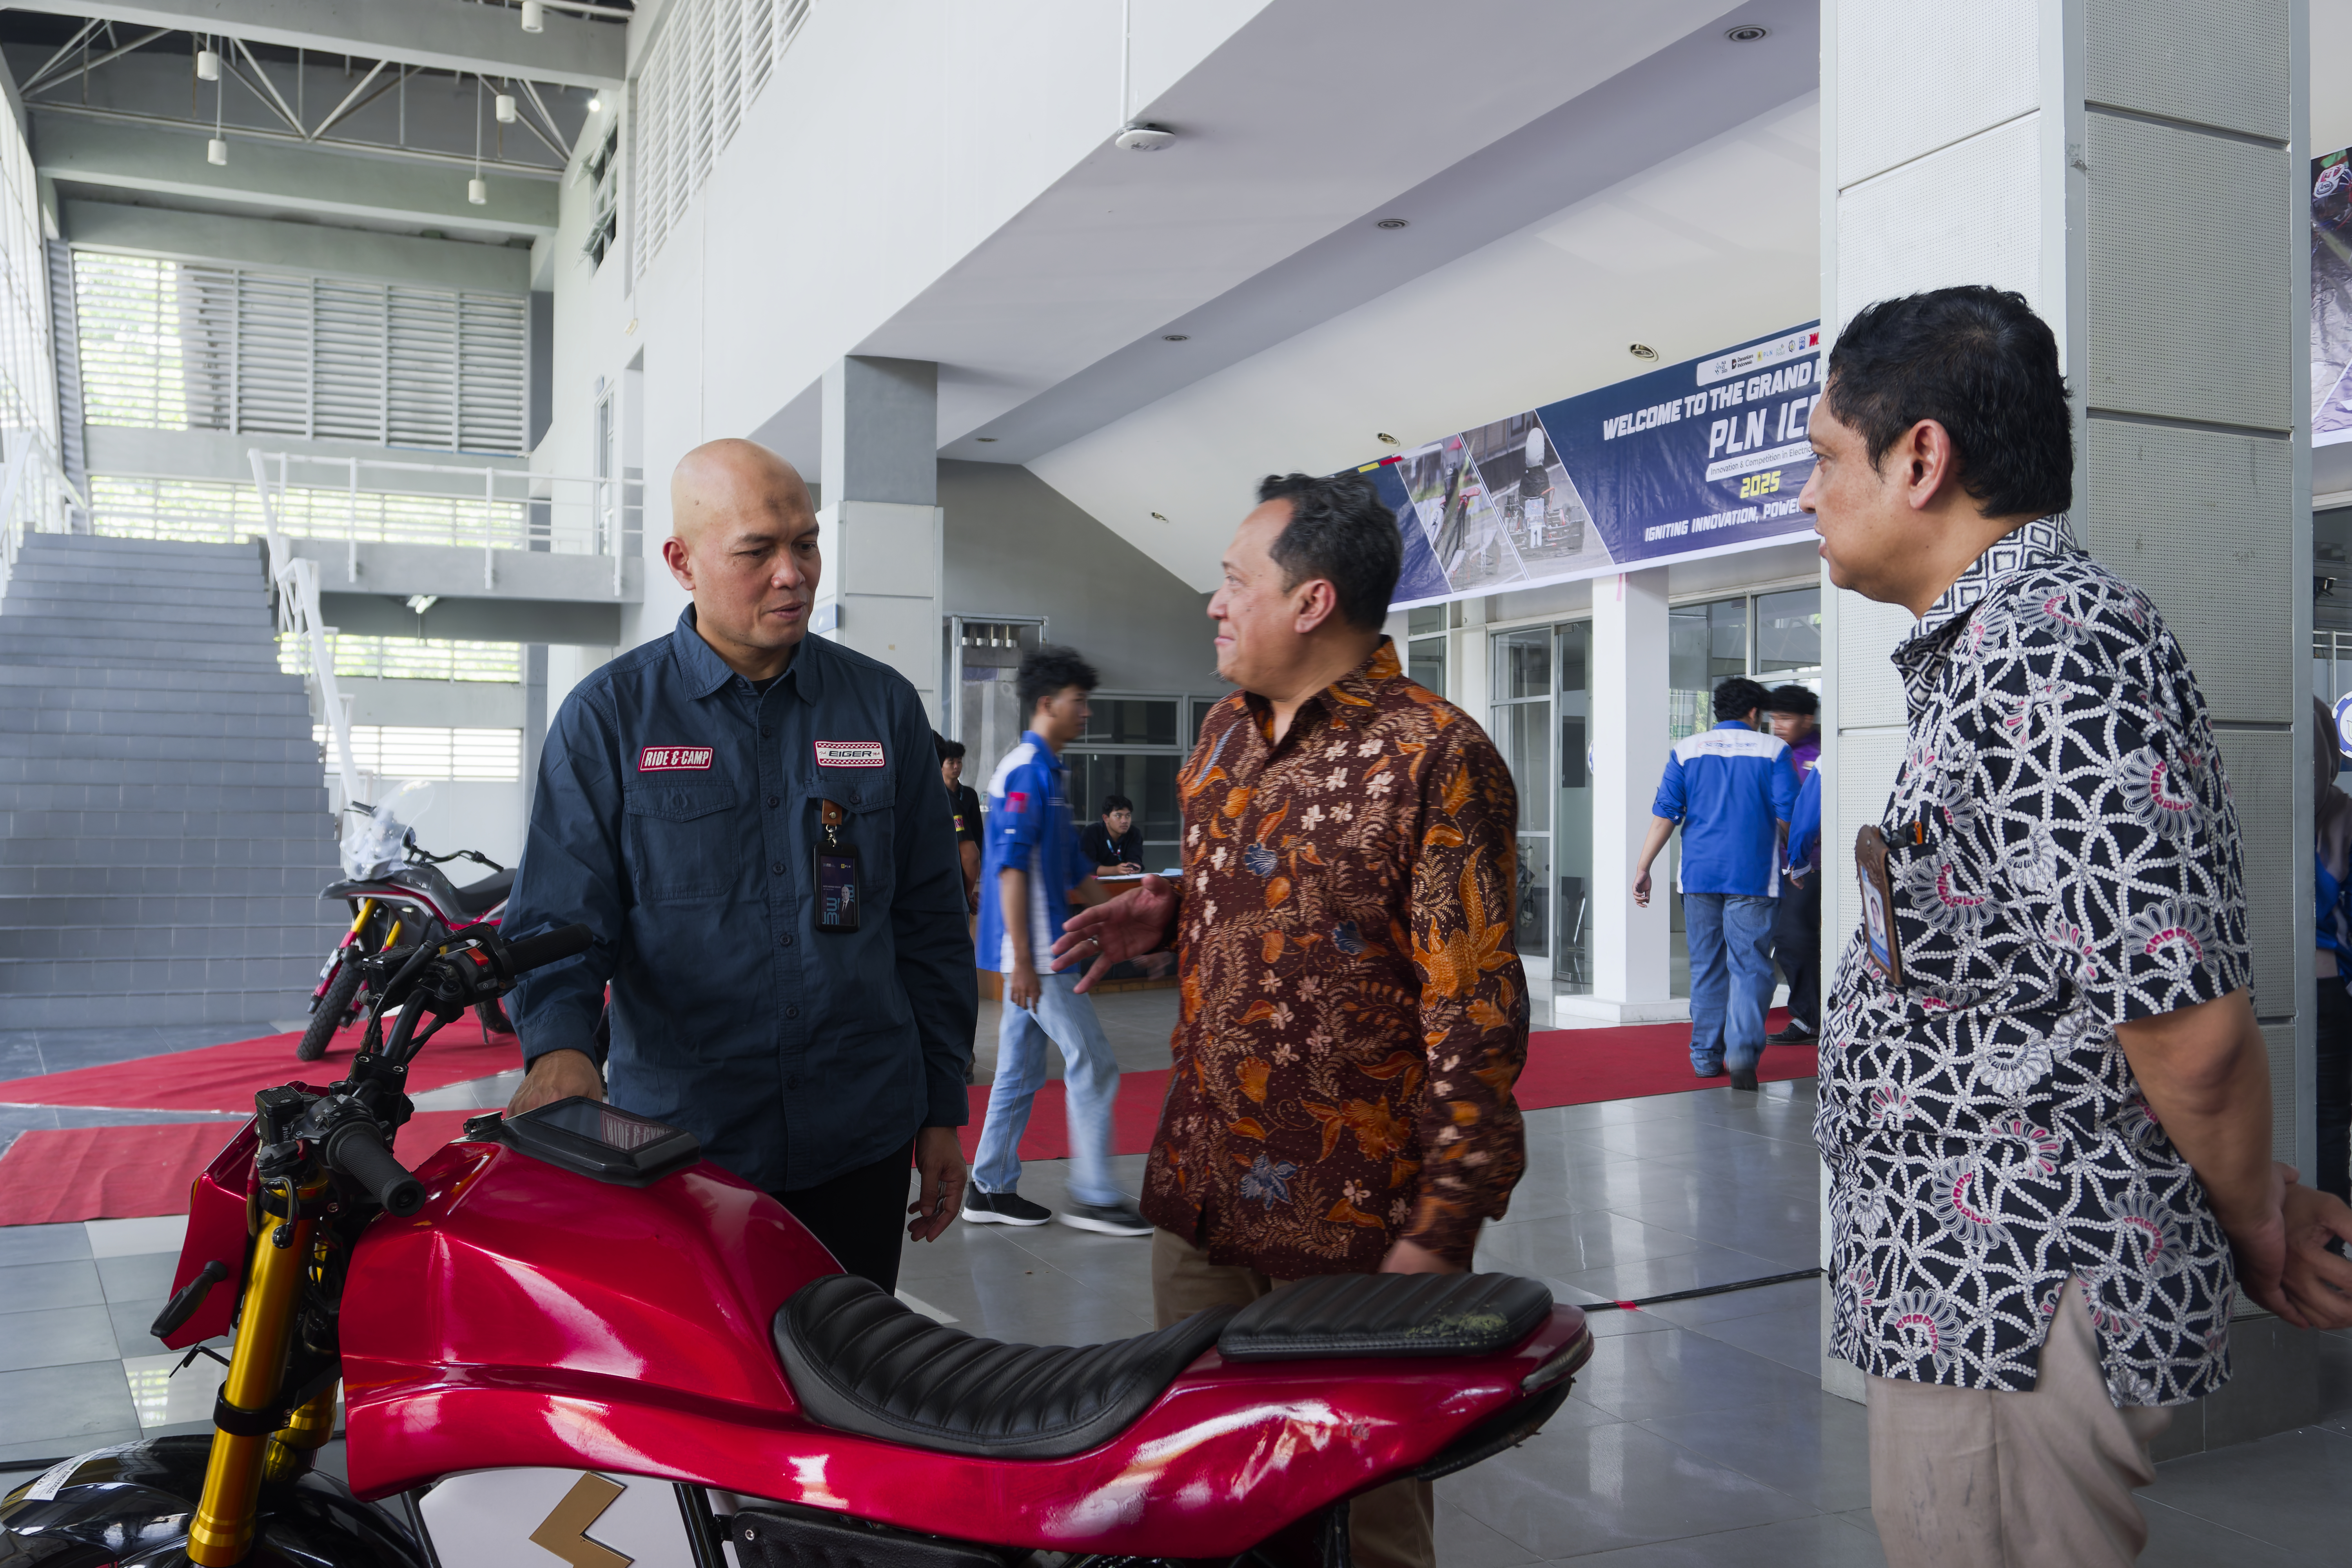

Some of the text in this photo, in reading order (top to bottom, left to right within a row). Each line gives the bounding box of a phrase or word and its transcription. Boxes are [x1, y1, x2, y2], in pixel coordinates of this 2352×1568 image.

[1604, 399, 1682, 441] WELCOME
[1684, 392, 1707, 418] TO
[1710, 381, 1745, 411] THE
[1746, 361, 1812, 401] GRAND
[1709, 408, 1767, 458] PLN
[1711, 463, 1739, 475] Innovation
[1746, 453, 1780, 467] Competition
[1782, 450, 1787, 459] in
[1740, 470, 1781, 498] 2025
[1645, 520, 1689, 542] IGNITING
[1691, 506, 1759, 533] INNOVATION,
[644, 751, 709, 766] RIDE & CAMP
